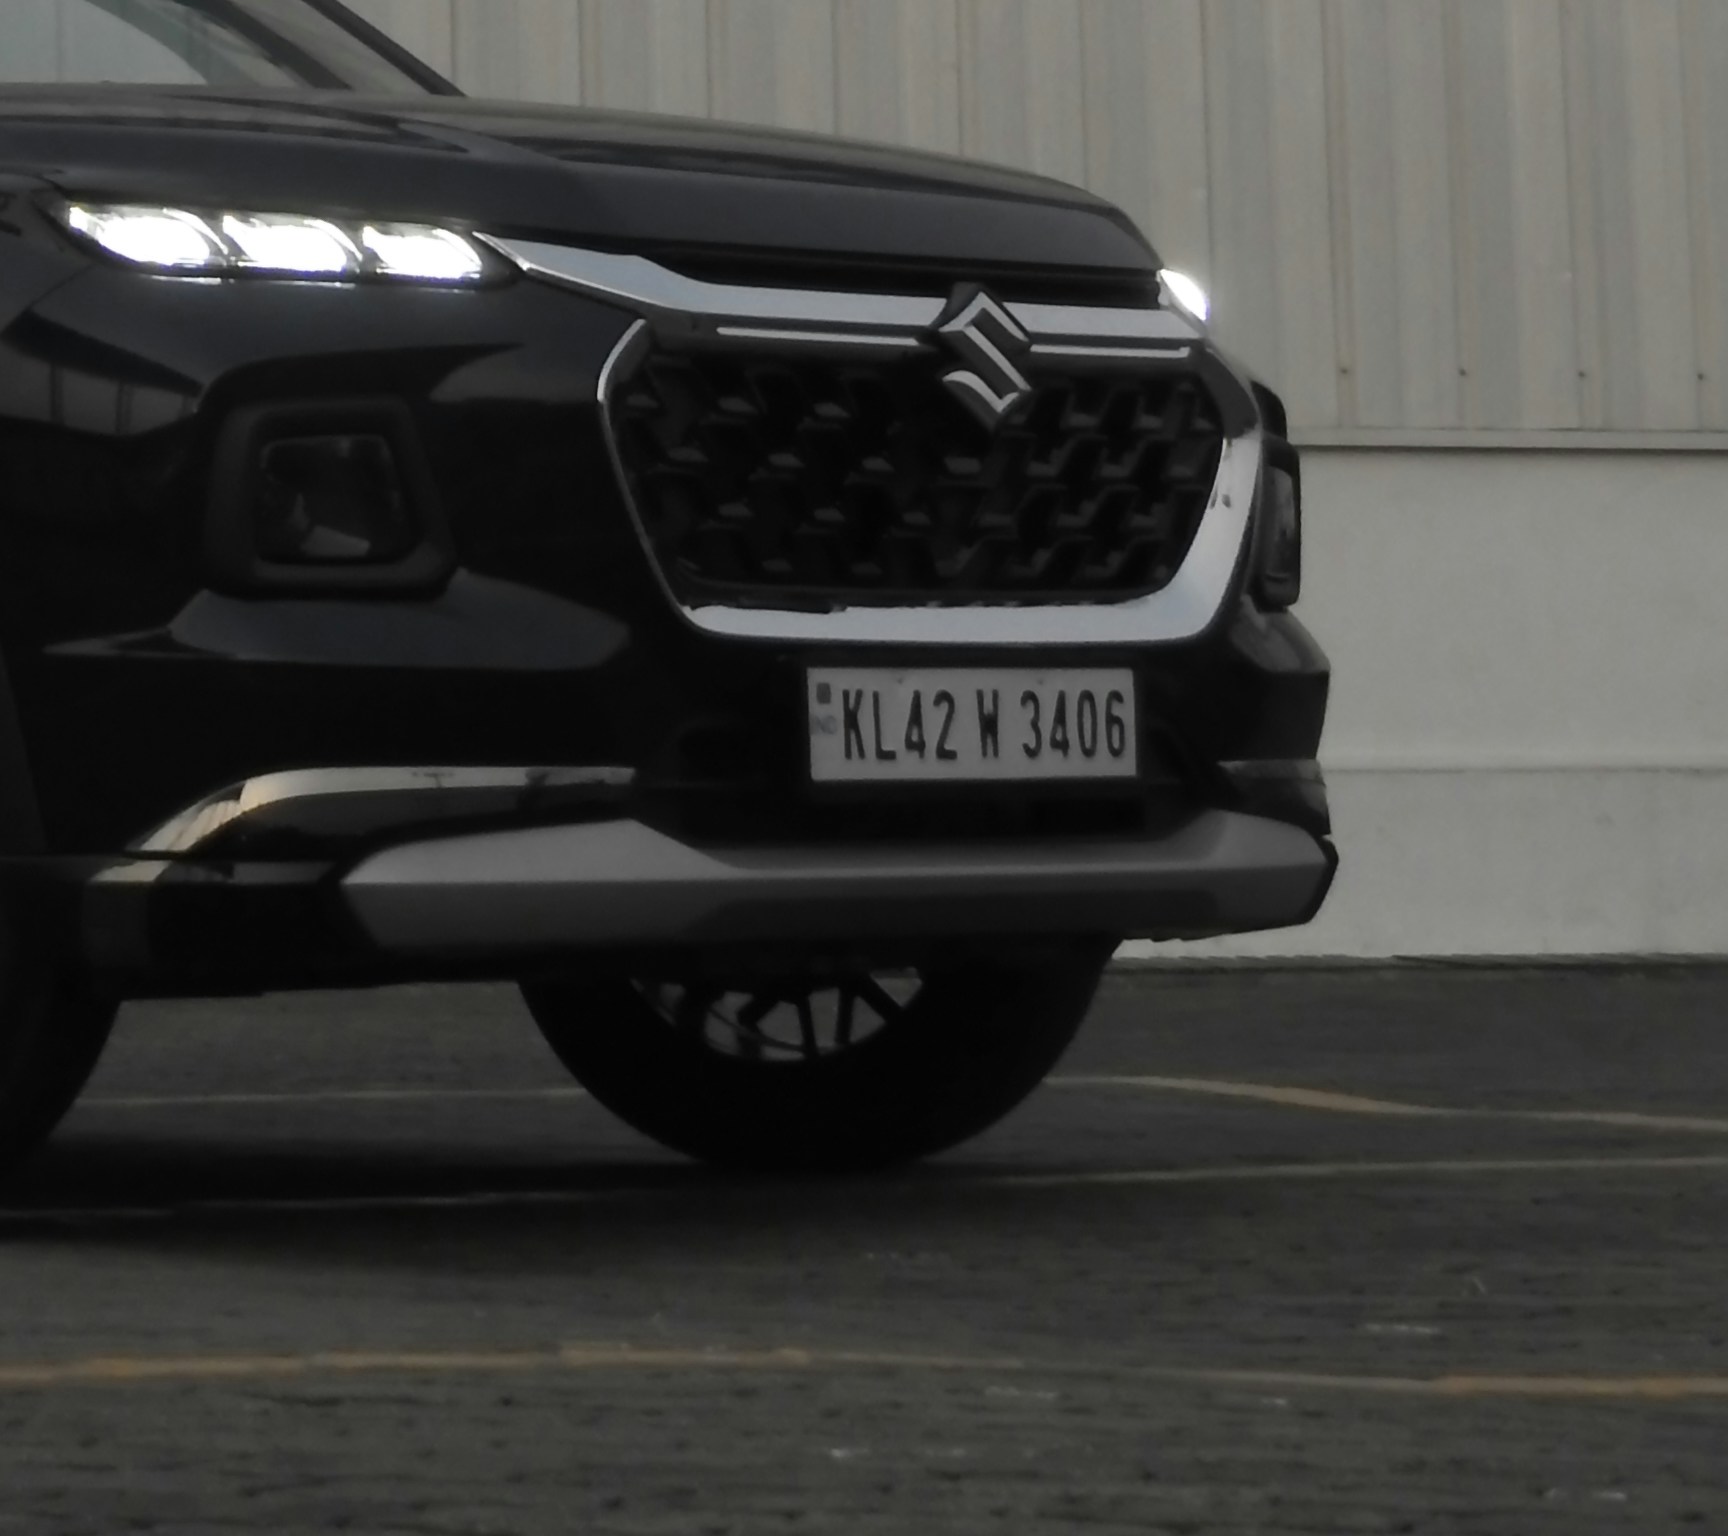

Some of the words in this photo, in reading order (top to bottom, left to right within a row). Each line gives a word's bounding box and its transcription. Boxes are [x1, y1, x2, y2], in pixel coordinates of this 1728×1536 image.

[841, 688, 959, 762] KL42
[975, 688, 1001, 760] W
[1019, 688, 1127, 761] 3406
